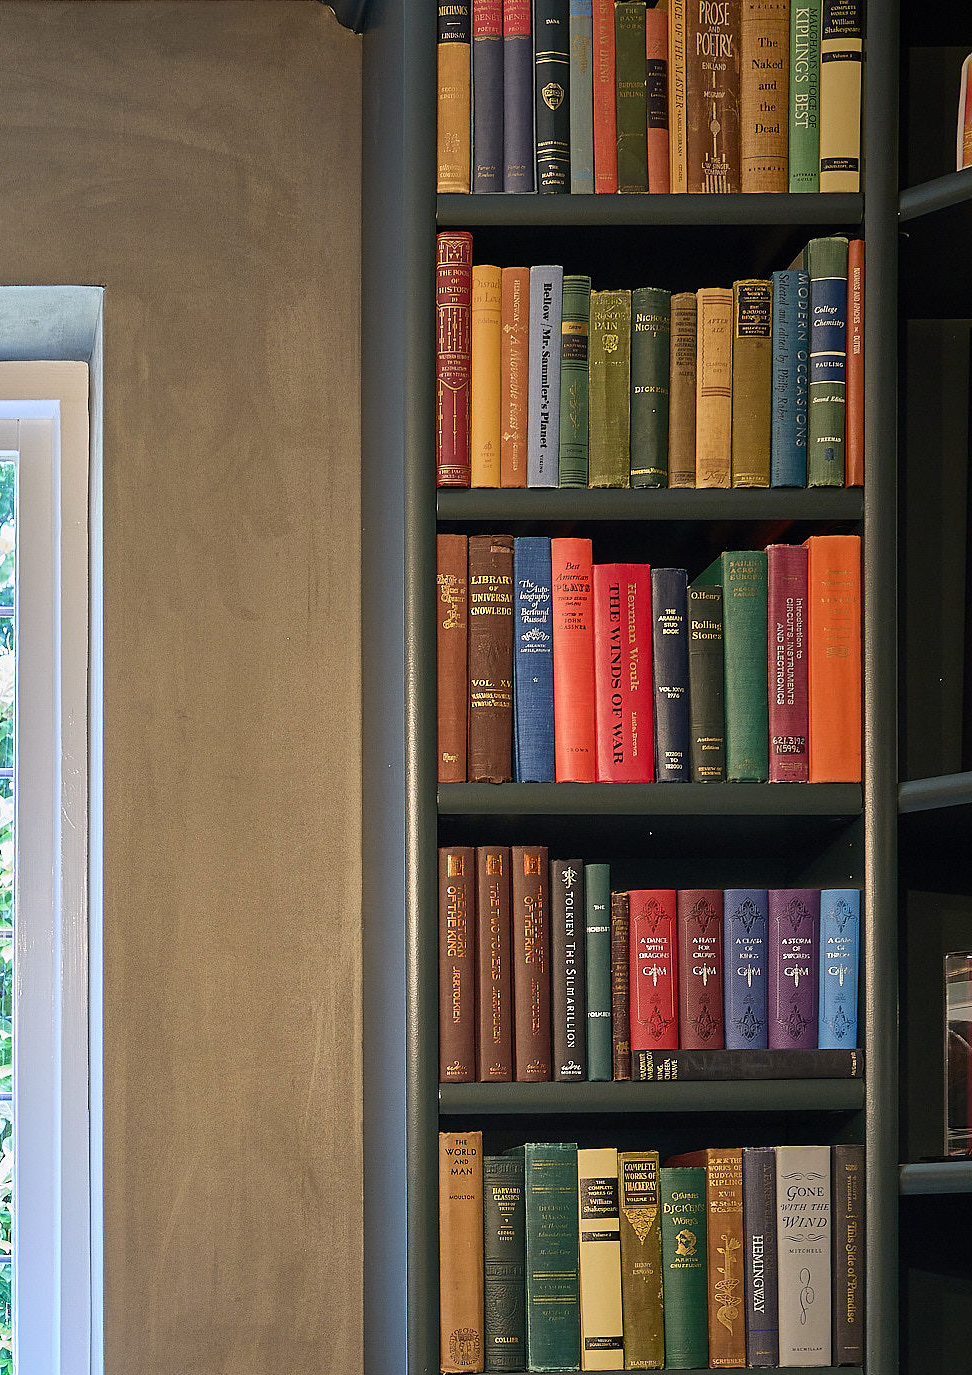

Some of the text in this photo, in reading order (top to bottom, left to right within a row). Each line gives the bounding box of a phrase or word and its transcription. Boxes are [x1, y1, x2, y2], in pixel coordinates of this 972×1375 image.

[438, 5, 467, 17] MECHANICS
[699, 1, 730, 26] PROSE
[831, 18, 856, 26] William
[824, 26, 861, 35] Shakespeare
[441, 32, 465, 40] LINDSAY
[696, 32, 733, 58] POETRY
[757, 37, 778, 48] The
[674, 23, 684, 109] OF THE MASTER
[702, 62, 727, 70] ENGLAND
[751, 59, 783, 70] Naked
[794, 7, 809, 129] KIPLING'S BEST
[759, 80, 777, 91] and
[808, 73, 818, 129] CHOICE OF
[760, 101, 776, 112] the
[754, 123, 780, 134] Dead
[542, 282, 553, 321] Bellow
[814, 305, 838, 315] College
[814, 320, 845, 332] Chemistry
[541, 327, 552, 350] Mr.
[775, 273, 790, 395] Selected and edited Philip
[795, 273, 809, 447] MODERN OCCASIONS
[815, 361, 844, 369] PAULING
[540, 350, 551, 410] Sammler's
[812, 396, 830, 404] Second
[538, 411, 549, 450] Planet
[564, 561, 581, 571] Best
[555, 574, 589, 582] American
[518, 579, 535, 589] The
[553, 583, 591, 593] PLAYS
[526, 586, 550, 594] Auto-
[519, 592, 550, 603] biography
[520, 607, 550, 616] Bertrand
[521, 615, 548, 624] Russell
[795, 598, 804, 645] Introduction
[691, 620, 723, 632] Rolling
[627, 582, 640, 692] Herman Wouk
[691, 631, 723, 641] Stones
[785, 597, 795, 706] CIRCUITS, INSTRUMENTS
[775, 622, 786, 706] AND ELECTRONICS
[608, 582, 625, 766] THE WINDS OF WAR
[471, 679, 495, 687] VOL.
[772, 736, 805, 745] 621.3192
[593, 903, 606, 911] THE
[446, 885, 458, 958] OF THE KING
[788, 937, 813, 945] STORM
[692, 952, 718, 960] CROWS
[781, 952, 811, 960] SWORDS
[564, 891, 578, 1049] TOLKIEN THE SILMARILLION
[638, 1053, 646, 1081] VLADIMIR
[646, 1050, 654, 1081] NABOKOV
[444, 1147, 478, 1157] WORLD
[453, 1158, 470, 1166] AND
[730, 1157, 743, 1165] THE
[449, 1167, 474, 1176] MAN
[624, 1162, 656, 1172] COMPLETE
[709, 1164, 743, 1173] WORKS OF
[624, 1172, 657, 1181] WORKS OF
[708, 1172, 743, 1180] RUDYARD
[624, 1181, 658, 1192] THACKERAY
[709, 1179, 743, 1188] KIPLING
[492, 1187, 522, 1195] HARVARD
[786, 1186, 825, 1202] GONE
[493, 1194, 521, 1202] CLASSICS
[589, 1197, 614, 1206] William
[583, 1206, 618, 1214] Shakespeare
[779, 1203, 830, 1212] WITH THE
[781, 1215, 828, 1230] WIND
[845, 1221, 858, 1243] This
[845, 1243, 857, 1267] Side
[752, 1234, 765, 1314] HEMINGWAY
[846, 1279, 858, 1323] Paradise
[494, 1336, 520, 1344] COLLIER
